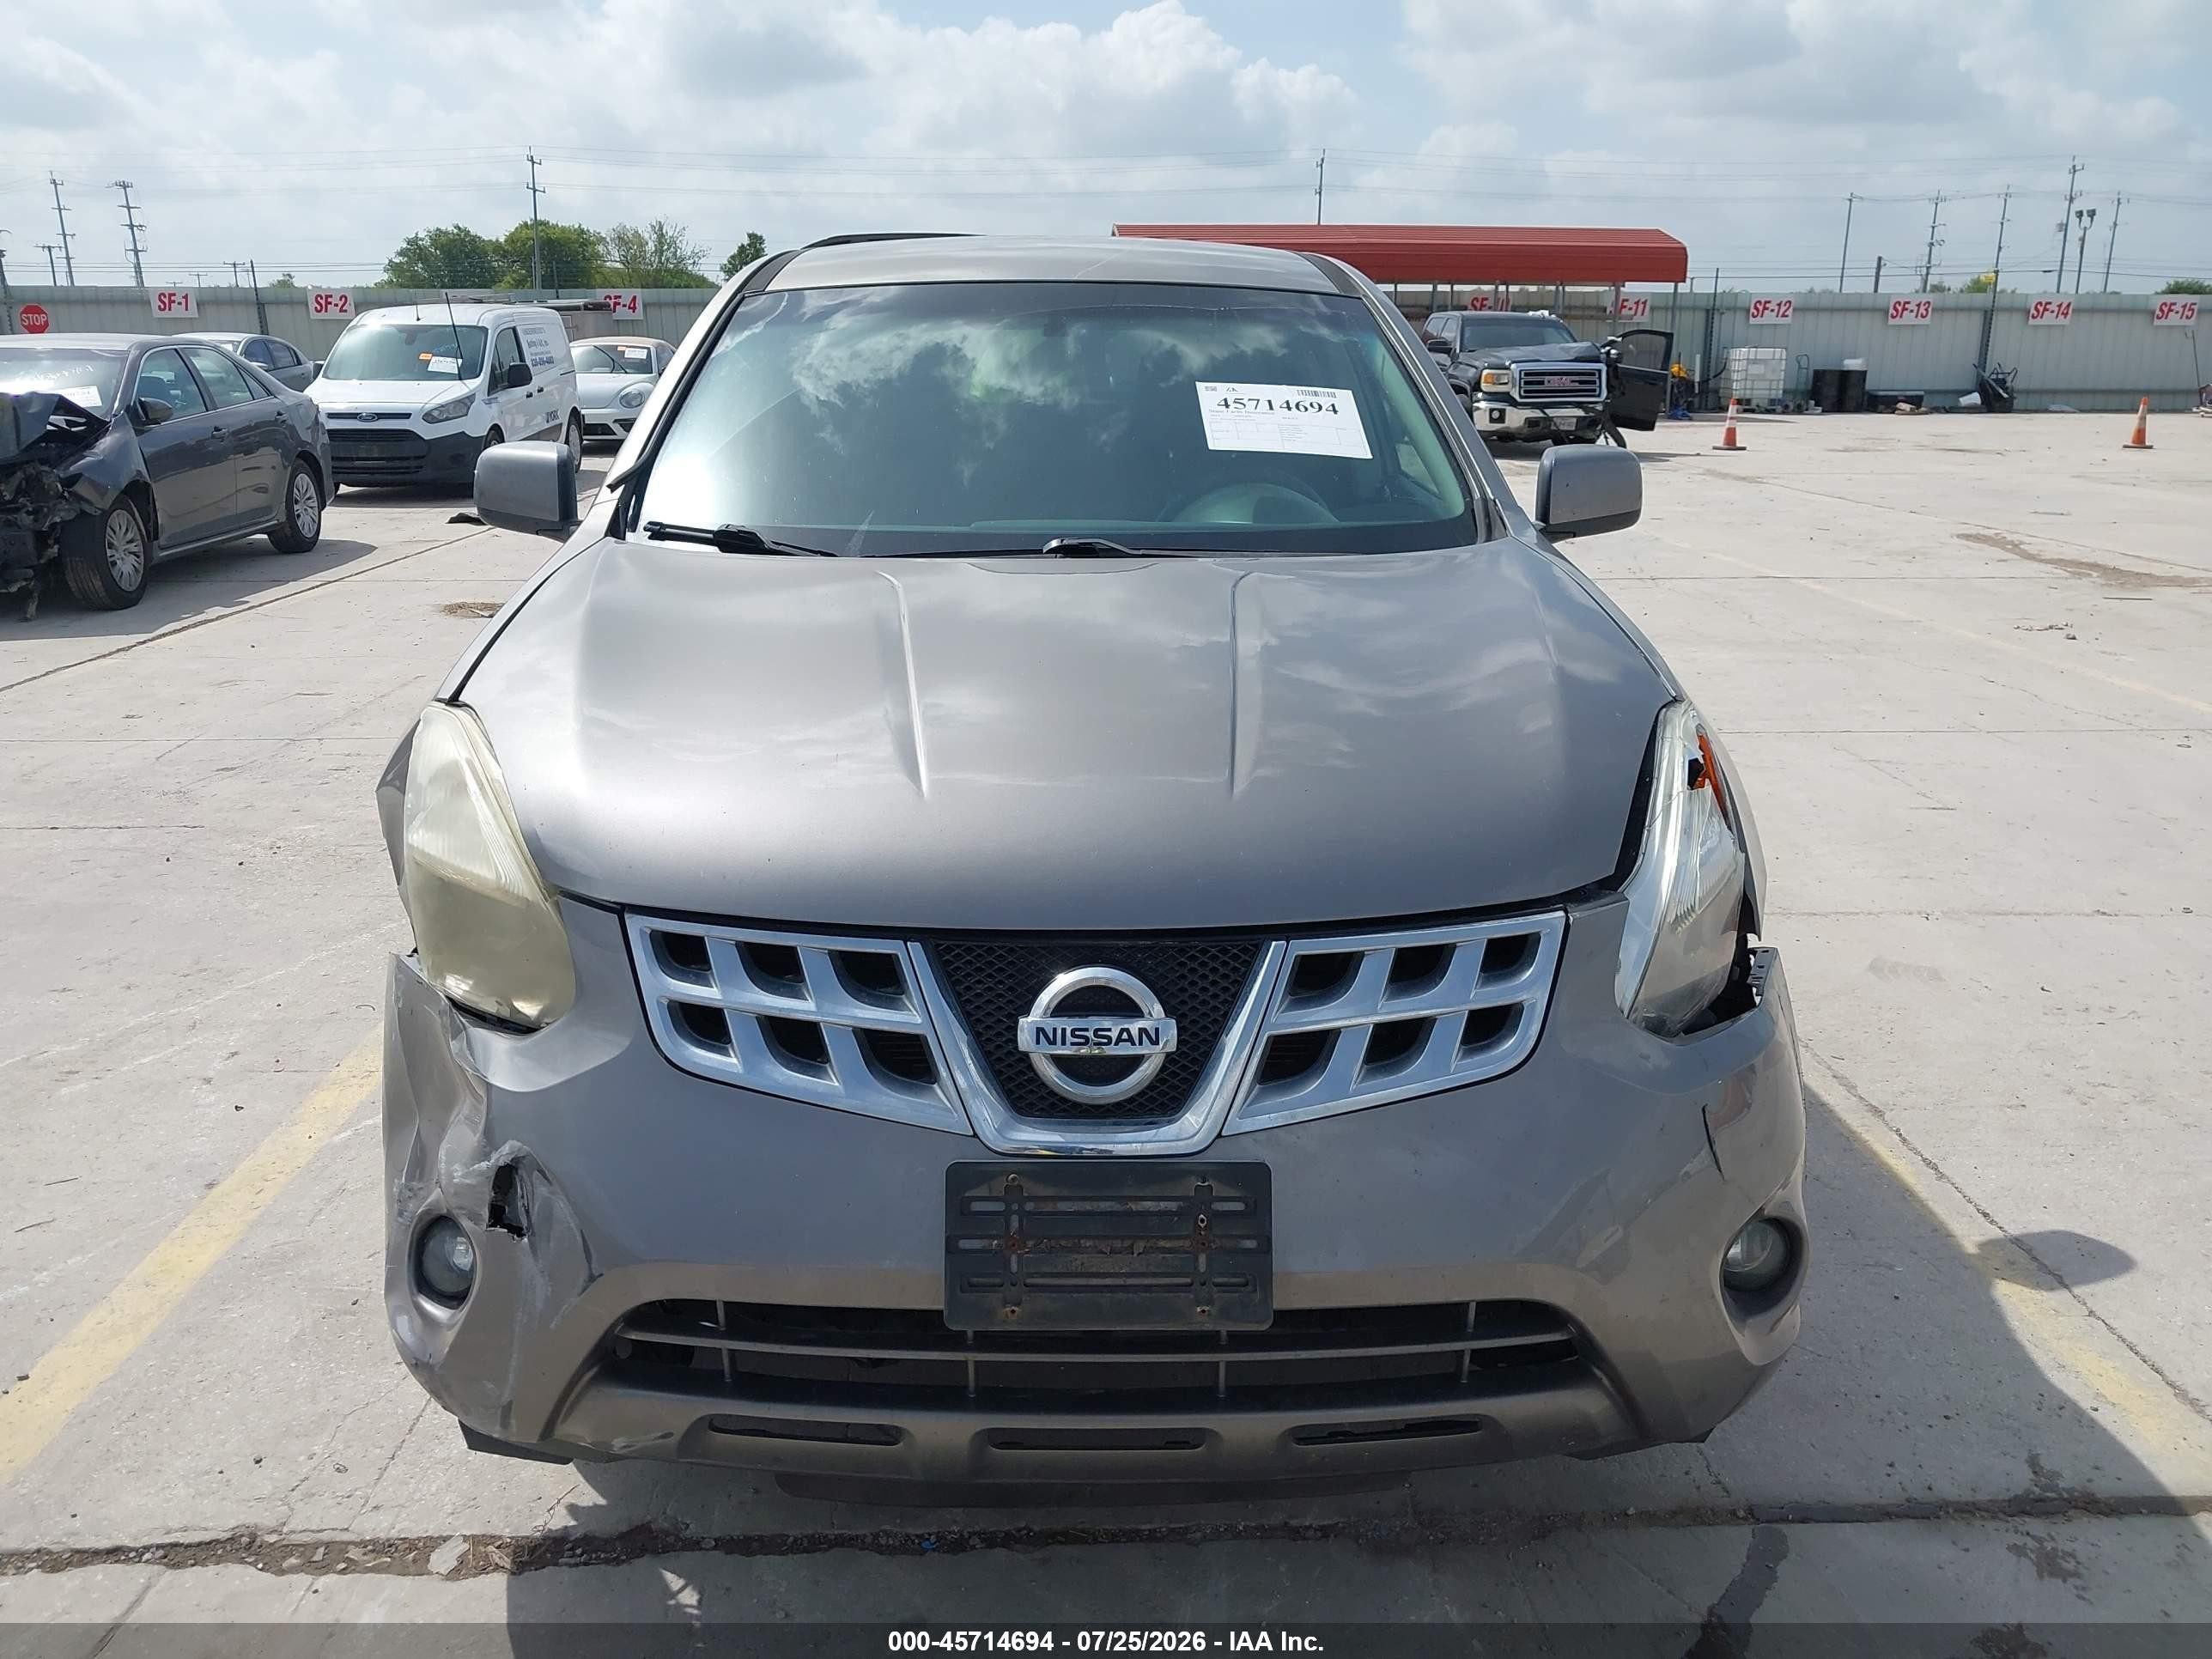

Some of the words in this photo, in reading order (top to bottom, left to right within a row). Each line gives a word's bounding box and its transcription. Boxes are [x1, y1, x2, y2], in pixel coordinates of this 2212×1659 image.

[157, 292, 189, 312] SF-1
[313, 294, 349, 314] SF-2
[1609, 298, 1648, 317] F-11
[1750, 299, 1793, 319] SF-12
[1889, 299, 1932, 320] SF-13
[2029, 300, 2073, 321] SF-14
[2154, 301, 2198, 321] SF-15
[21, 313, 48, 327] STOP
[1217, 398, 1340, 415] 45714694
[1035, 1026, 1160, 1047] NISSAN
